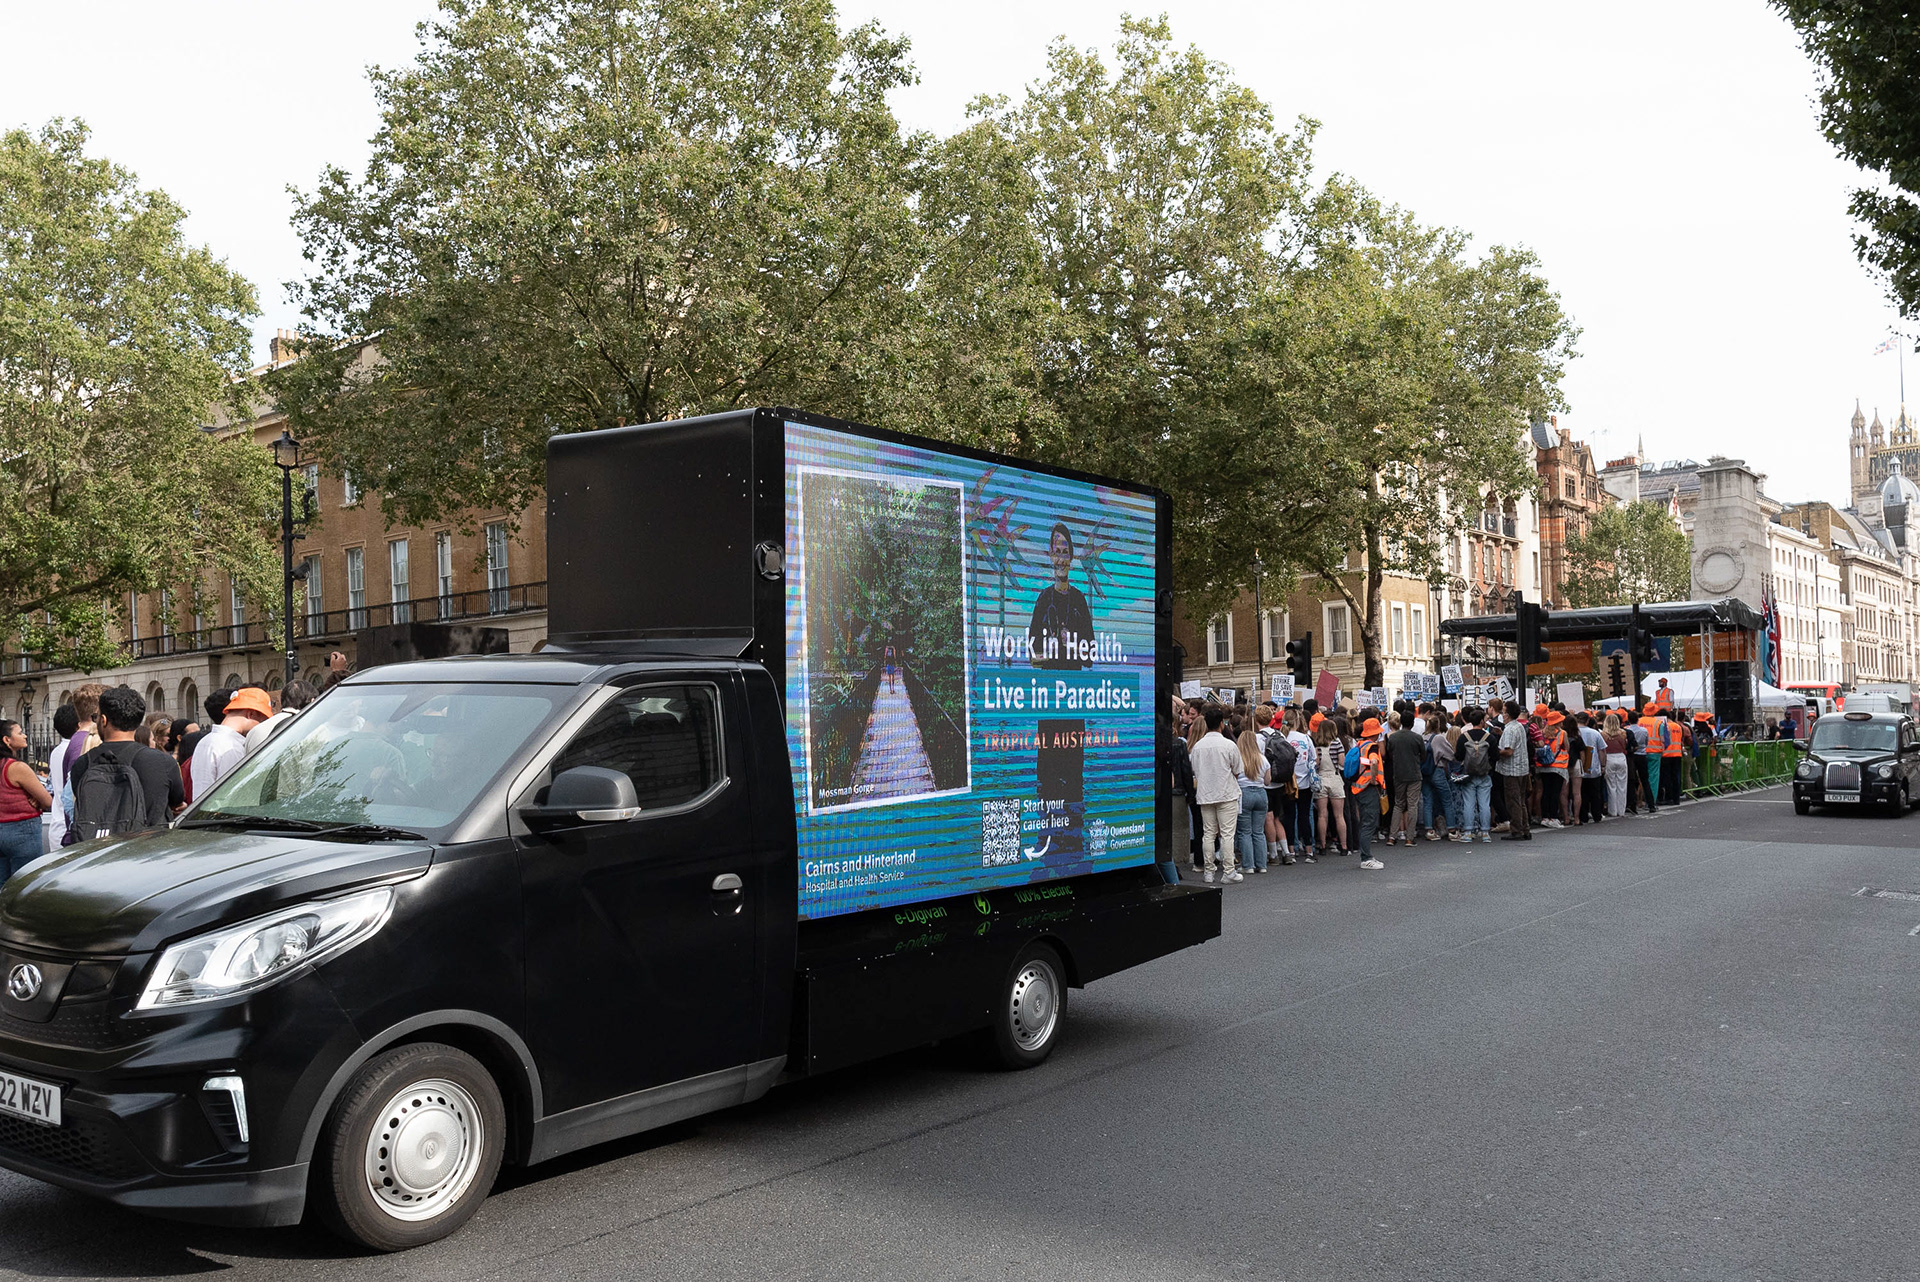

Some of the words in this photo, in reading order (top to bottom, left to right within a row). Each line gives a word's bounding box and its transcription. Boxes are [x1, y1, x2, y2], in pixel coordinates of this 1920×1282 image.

[983, 626, 1036, 658] Work
[1042, 628, 1059, 660] in
[1066, 631, 1128, 662] Health.
[984, 677, 1025, 709] Live
[1031, 678, 1048, 709] in
[1055, 679, 1136, 709] Paradise.
[983, 732, 1048, 751] TROPICAL
[1053, 731, 1119, 748] AUSTRALIA
[819, 786, 852, 798] Mossman
[853, 784, 875, 795] Gorge
[1023, 799, 1045, 813] Start
[1046, 799, 1065, 814] your
[1023, 818, 1049, 831] career
[1050, 814, 1070, 828] here
[1110, 822, 1145, 838] Queensland
[1110, 836, 1145, 850] Government
[805, 860, 840, 877] Cairns
[842, 855, 861, 873] and
[864, 849, 916, 869] Hinterland
[805, 878, 838, 893] Hospital
[839, 876, 854, 888] and
[854, 873, 878, 886] Health
[879, 870, 905, 882] Service
[1014, 889, 1041, 904] 100%
[1042, 884, 1073, 900] Electric
[894, 905, 948, 925] e-Digivan
[21, 1082, 52, 1117] WZV
